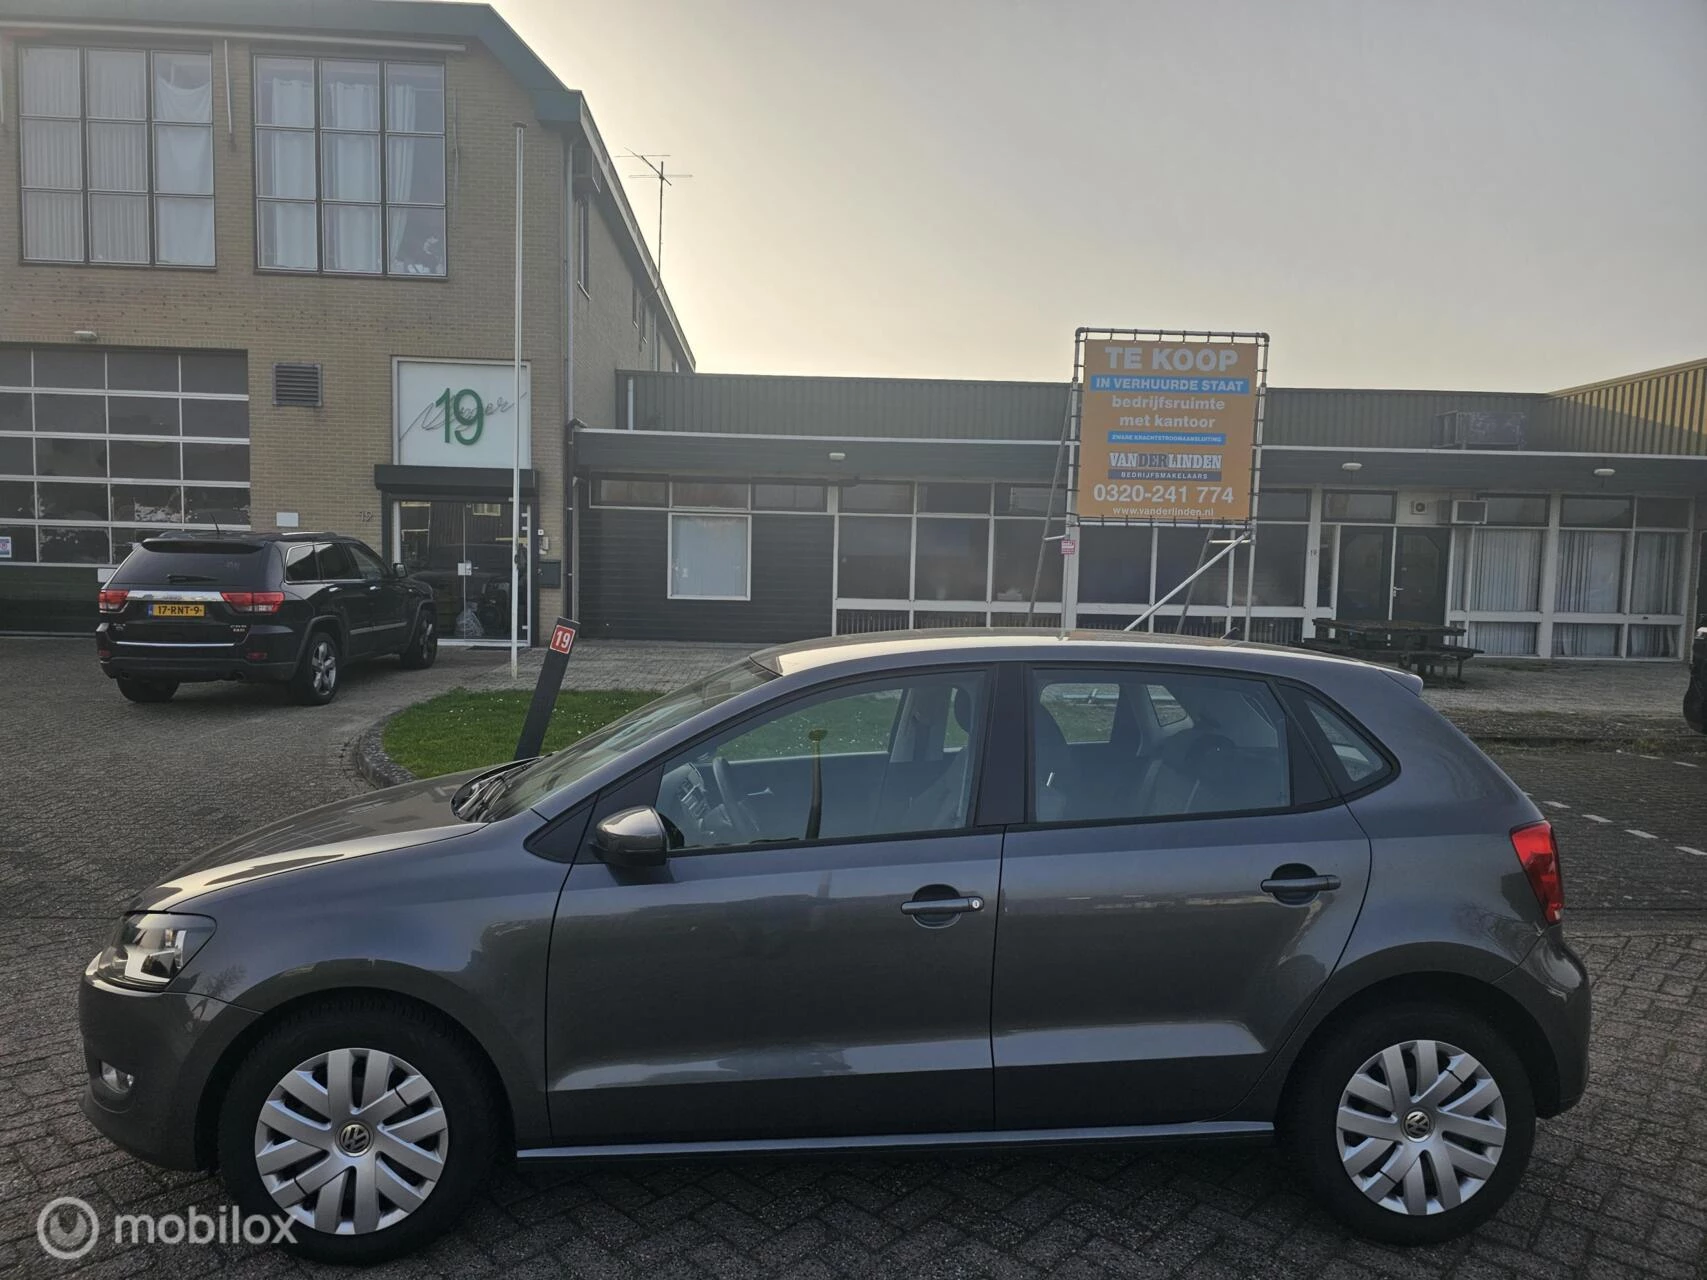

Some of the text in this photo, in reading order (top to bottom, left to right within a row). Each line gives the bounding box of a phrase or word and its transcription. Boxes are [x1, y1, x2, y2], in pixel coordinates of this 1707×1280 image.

[1104, 347, 1238, 372] TE KOOP
[1096, 376, 1243, 392] IN VERHUURDE STAAT
[1111, 395, 1225, 411] bedrijfsruimte
[435, 387, 484, 446] 19
[1119, 414, 1216, 428] met kantoor
[1121, 471, 1208, 480] BEDRIJFSMAKELAARS
[1093, 484, 1234, 504] 0320-241 774
[1112, 506, 1214, 517] www.vanderlinden.nl
[158, 604, 200, 615] 17-RNT-9
[555, 630, 571, 649] 19
